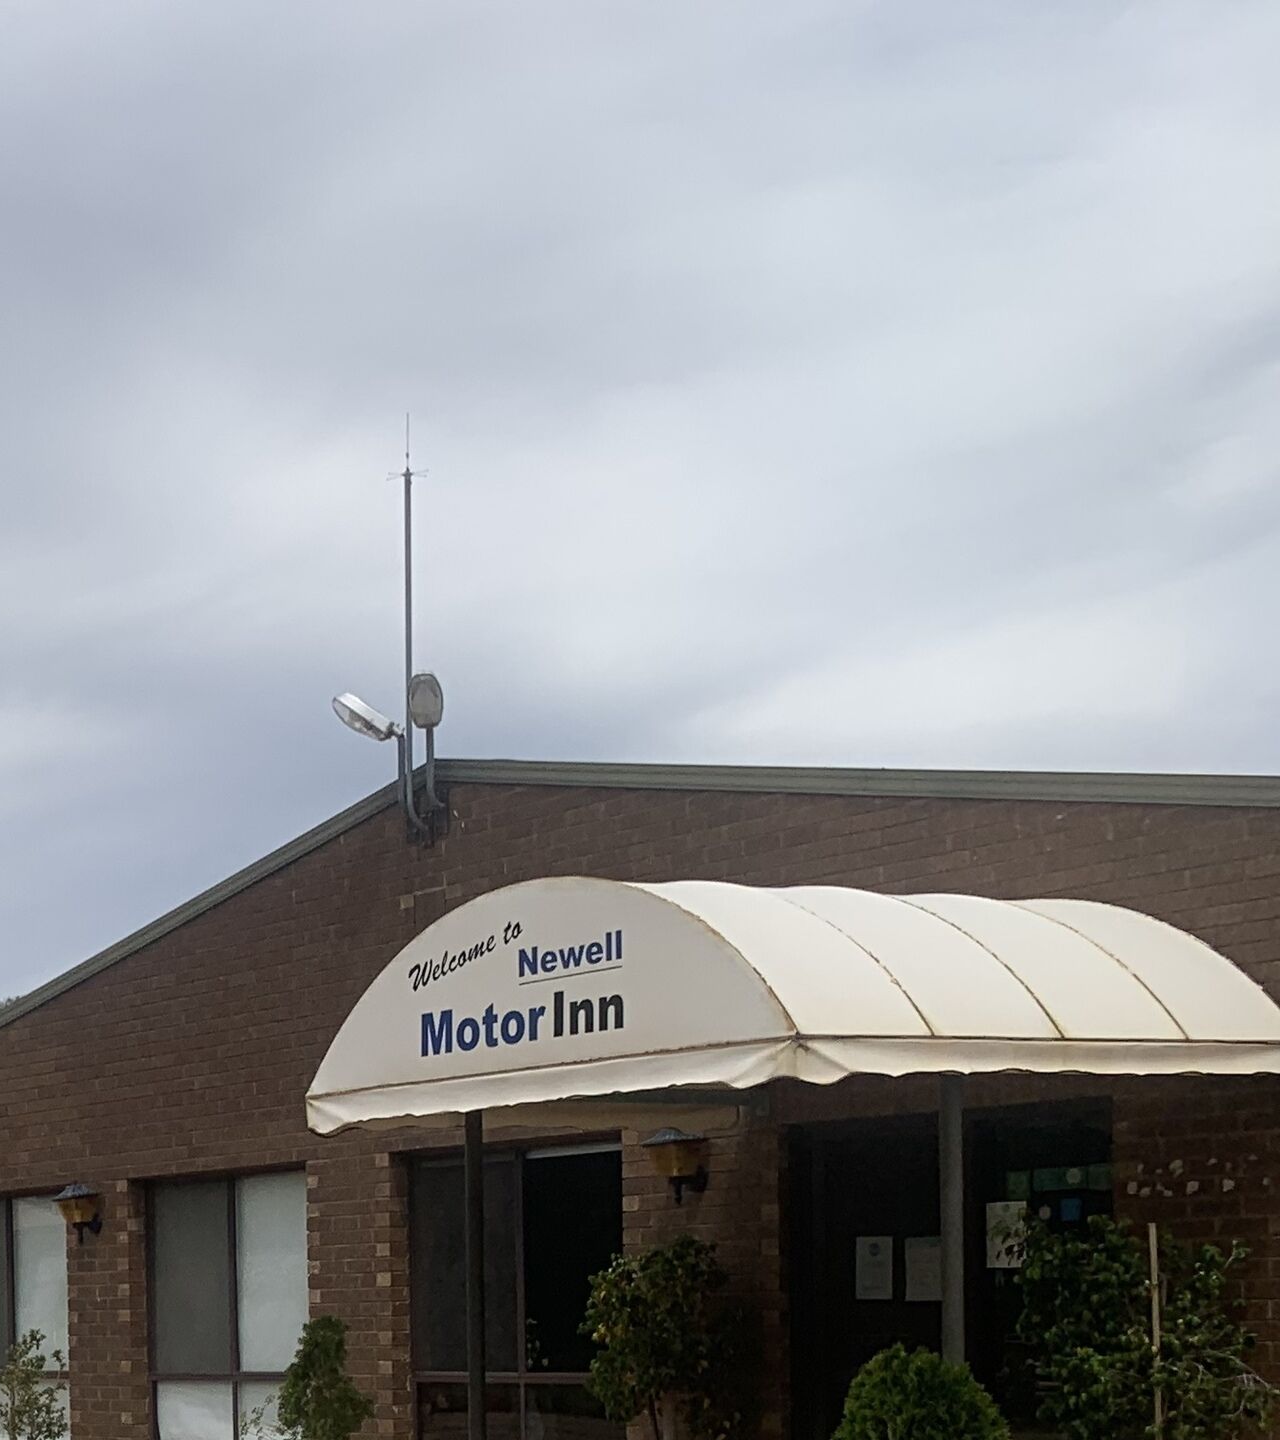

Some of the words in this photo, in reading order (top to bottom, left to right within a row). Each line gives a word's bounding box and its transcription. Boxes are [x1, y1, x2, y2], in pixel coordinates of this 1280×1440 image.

[409, 935, 496, 992] Welcome
[503, 921, 522, 944] to
[518, 930, 622, 978] Newell
[421, 1003, 546, 1057] Motor
[553, 991, 624, 1037] Inn
